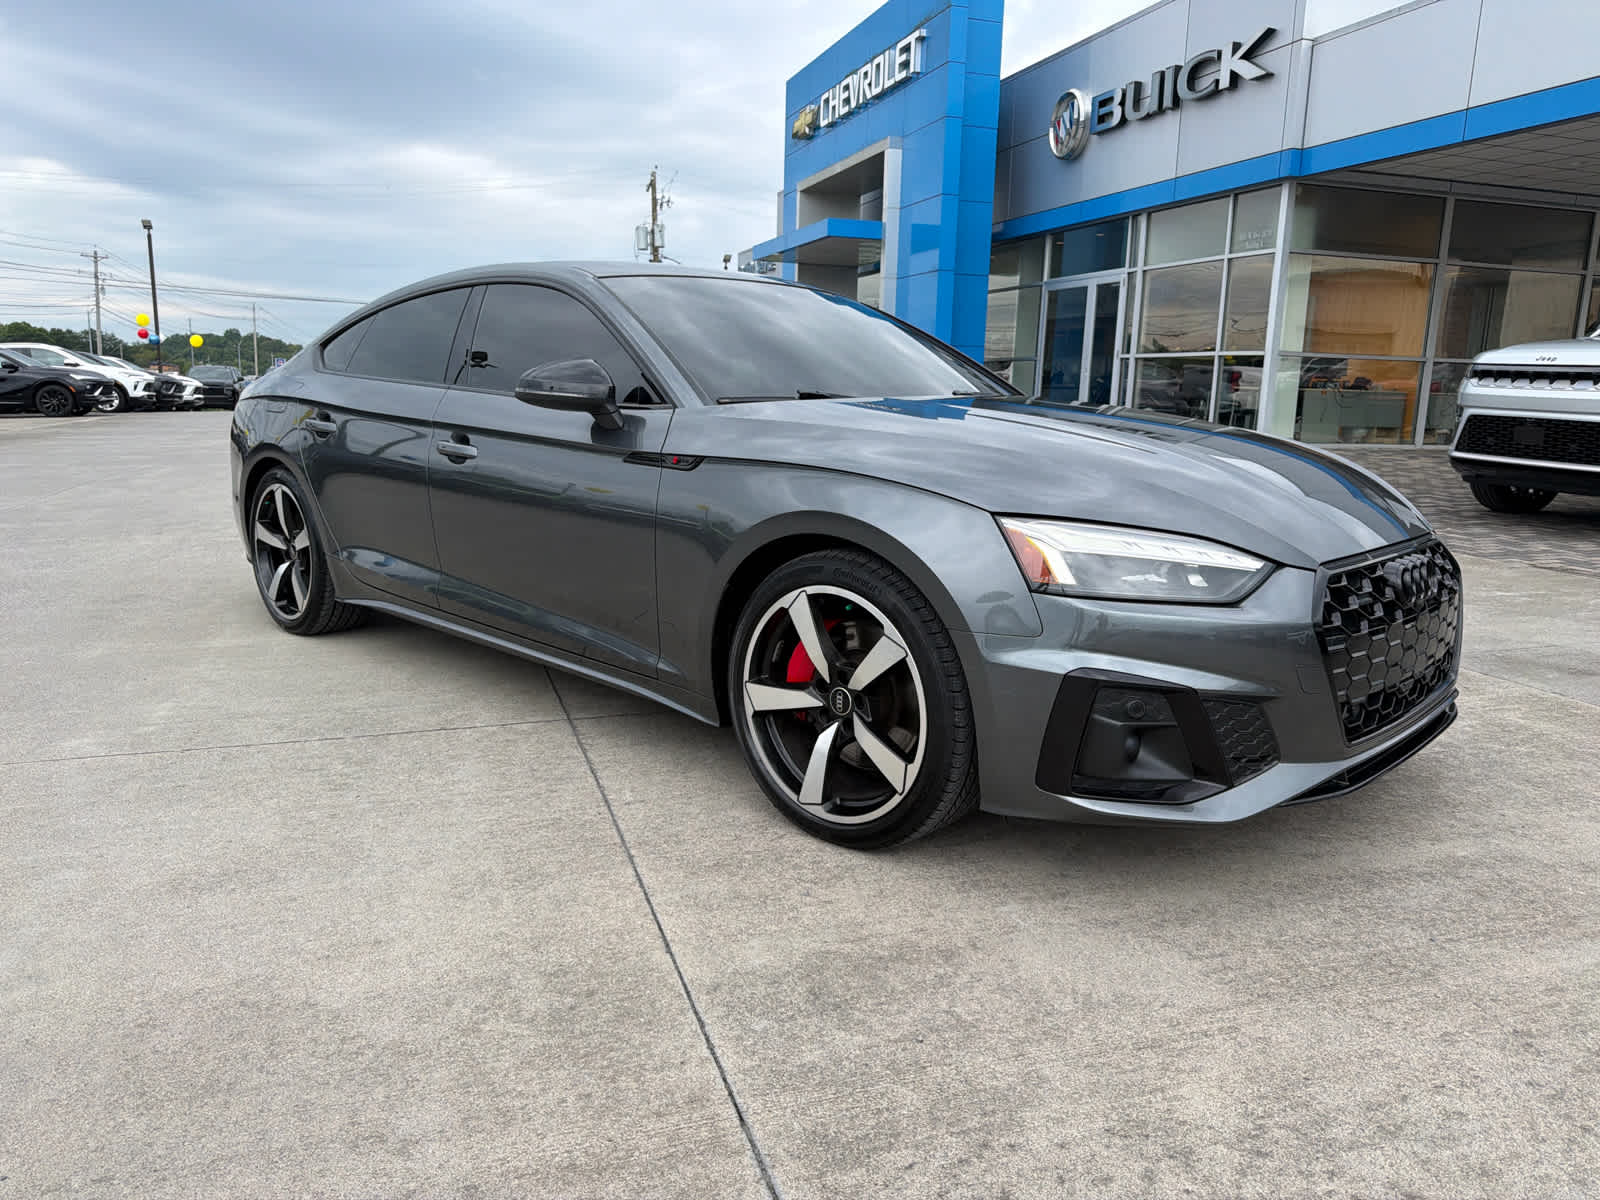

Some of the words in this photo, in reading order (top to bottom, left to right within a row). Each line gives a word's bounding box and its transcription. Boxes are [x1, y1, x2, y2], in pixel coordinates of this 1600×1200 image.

[820, 28, 926, 128] CHEVROLET
[1089, 27, 1277, 135] BUICK
[1535, 355, 1558, 363] Jeep
